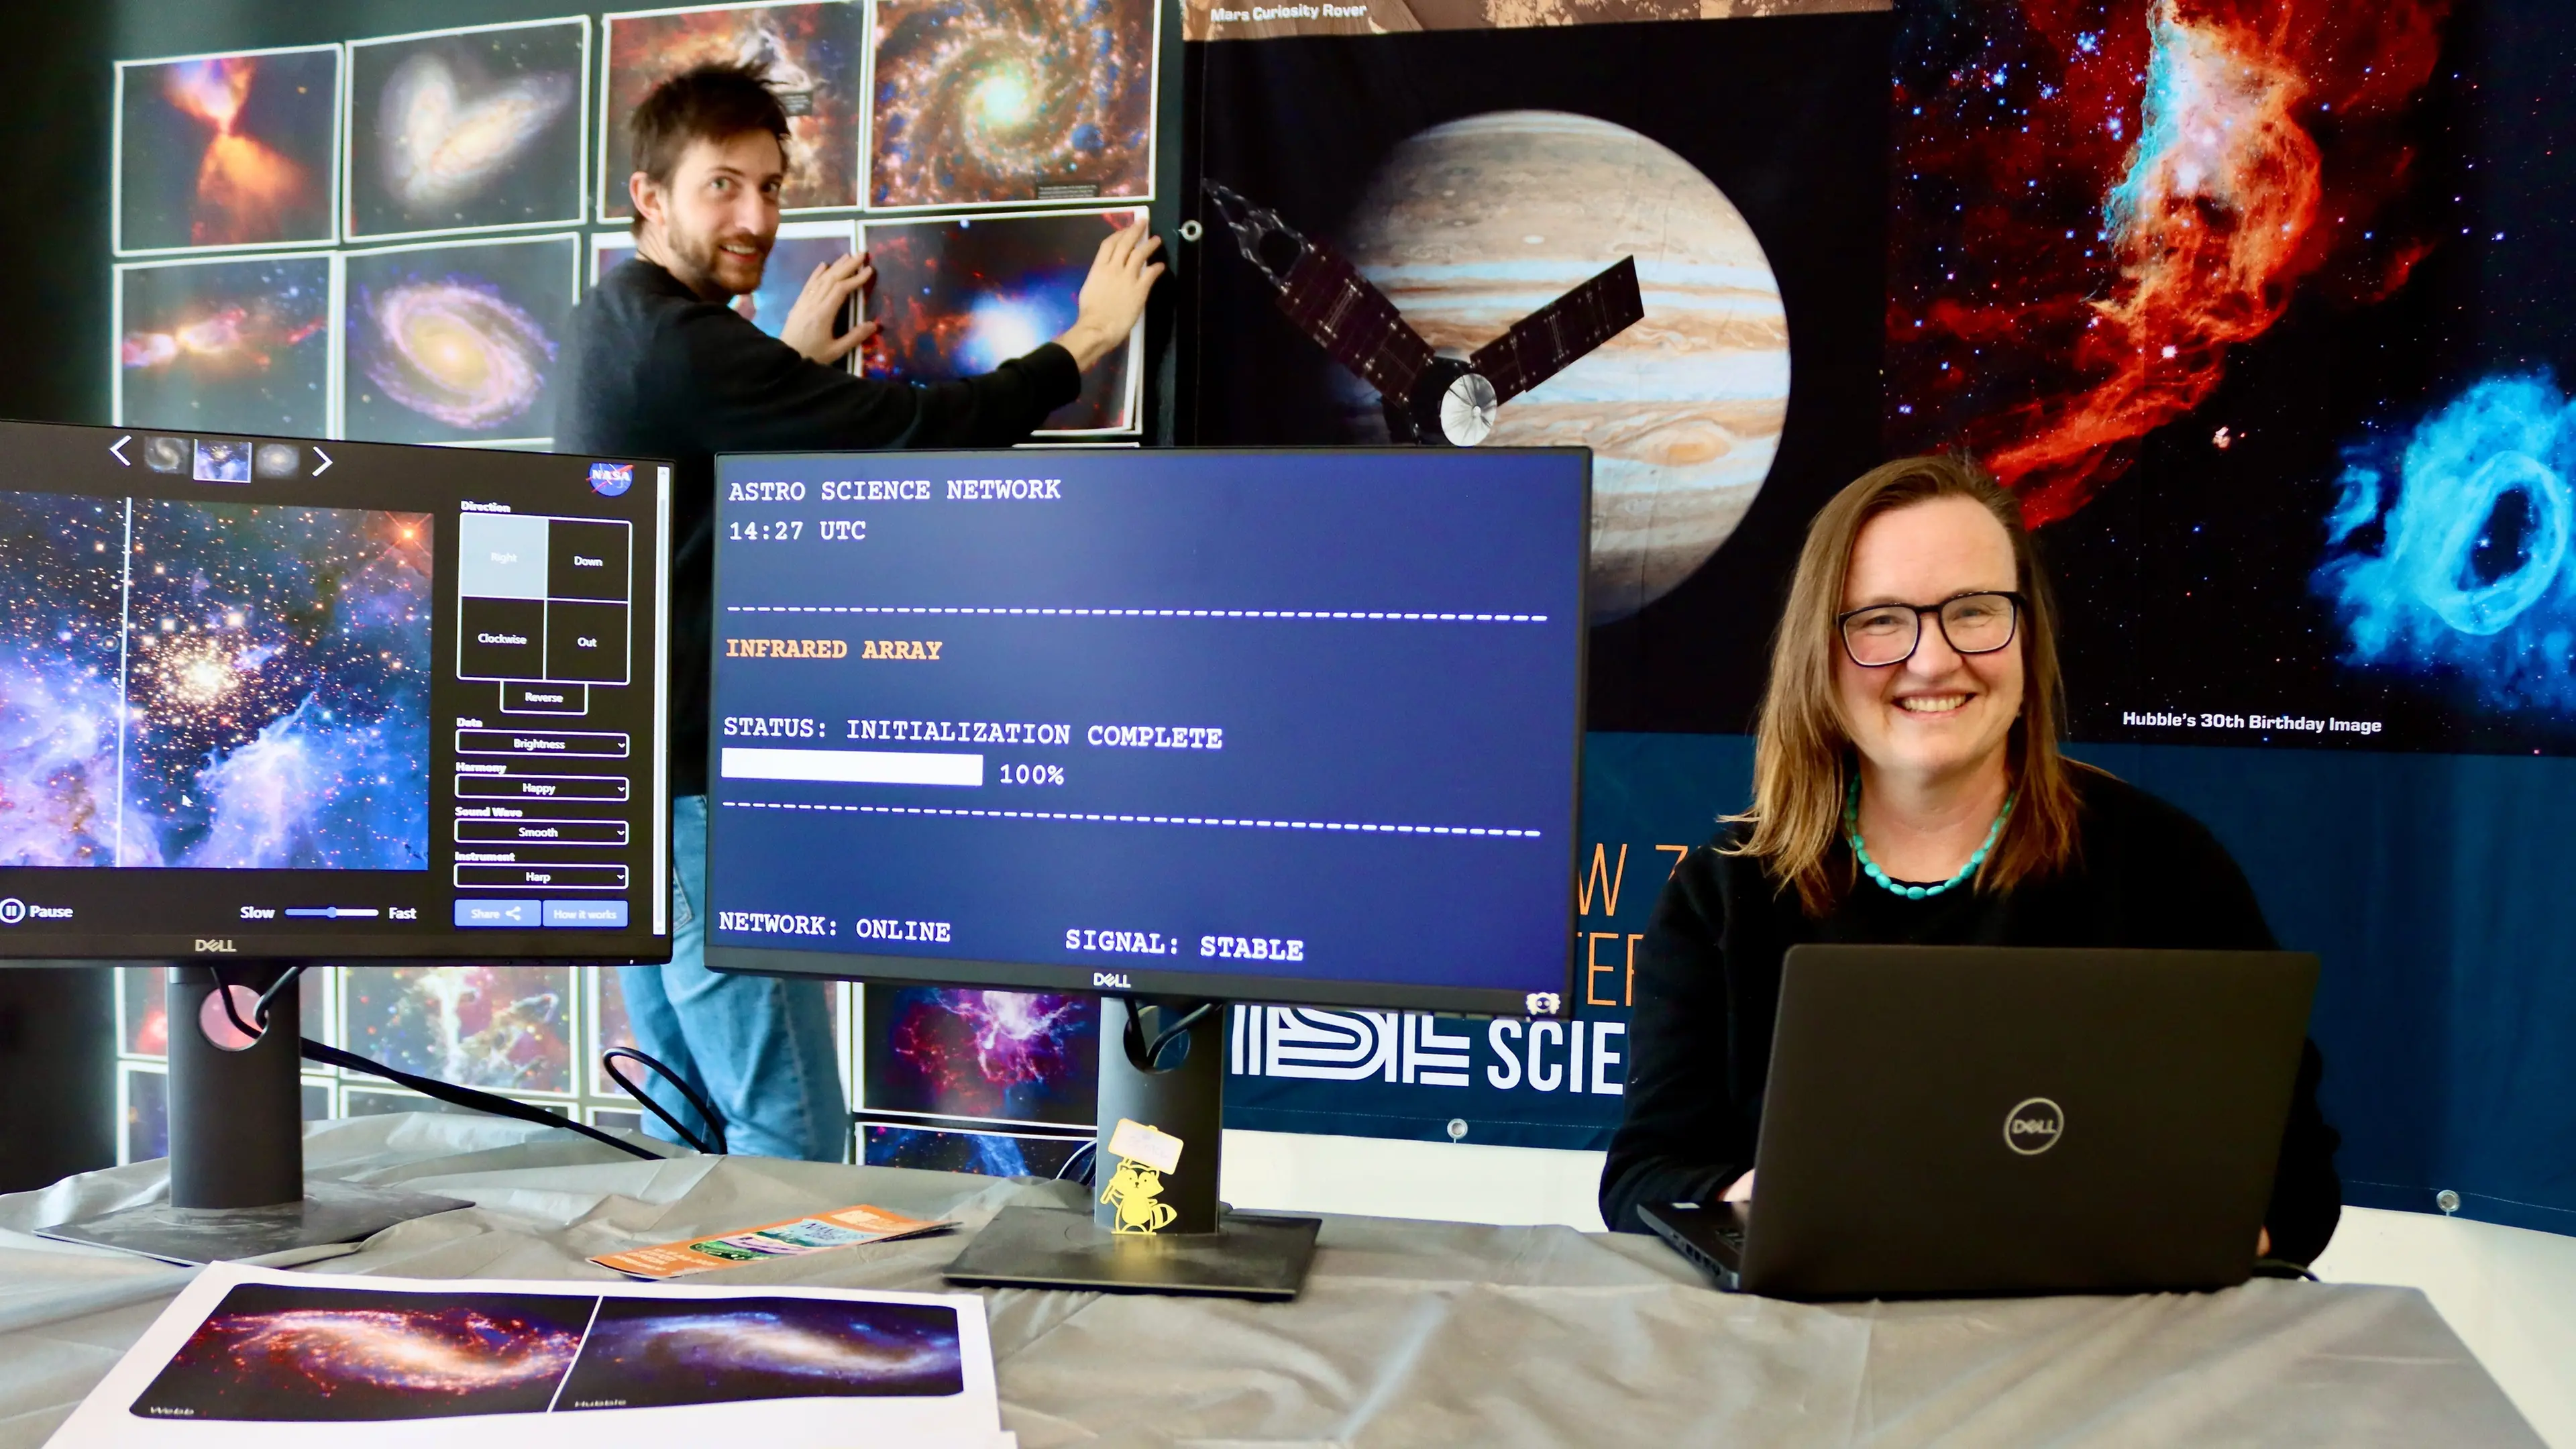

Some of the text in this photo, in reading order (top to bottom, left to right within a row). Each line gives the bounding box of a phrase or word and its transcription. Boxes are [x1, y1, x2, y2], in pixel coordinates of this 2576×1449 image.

[1210, 3, 1367, 22] Mars Curiosity Rover
[592, 468, 631, 482] NASA
[728, 479, 1061, 501] ASTRO SCIENCE NETWORK
[460, 500, 511, 513] Direction
[730, 521, 866, 540] 14:27 UTC
[490, 552, 517, 564] Right
[574, 555, 603, 567] Down
[478, 633, 527, 645] Clockwise
[577, 637, 597, 647] Out
[726, 639, 943, 660] INFRARED ARRAY
[525, 692, 564, 703] Reverse
[456, 717, 483, 728] Data
[2200, 713, 2245, 729] 30th
[2249, 714, 2325, 734] Birthday
[2329, 717, 2382, 735] Image
[724, 716, 1222, 749] STATUS: INITIALIZATION COMPLETE
[513, 739, 566, 751] Brightness
[455, 762, 507, 774] Harmony
[1000, 763, 1065, 786] 100%
[522, 783, 556, 796] Happy
[454, 806, 523, 818] Sound Wave
[518, 826, 559, 837] Smooth
[454, 851, 516, 862] Instrument
[525, 871, 551, 884] Harp
[30, 905, 74, 918] Pause
[240, 906, 276, 919] Slow
[388, 907, 417, 920] Fast
[471, 908, 500, 919] Share
[553, 909, 617, 919] How it works
[718, 911, 951, 943] NETWORK: ONLINE
[195, 938, 237, 953] DELL
[1065, 928, 1303, 961] SIGNAL: STABLE
[1093, 972, 1132, 988] DELL
[2013, 1118, 2057, 1134] DELL
[574, 1399, 627, 1408] Hubble
[150, 1407, 195, 1415] Webb
